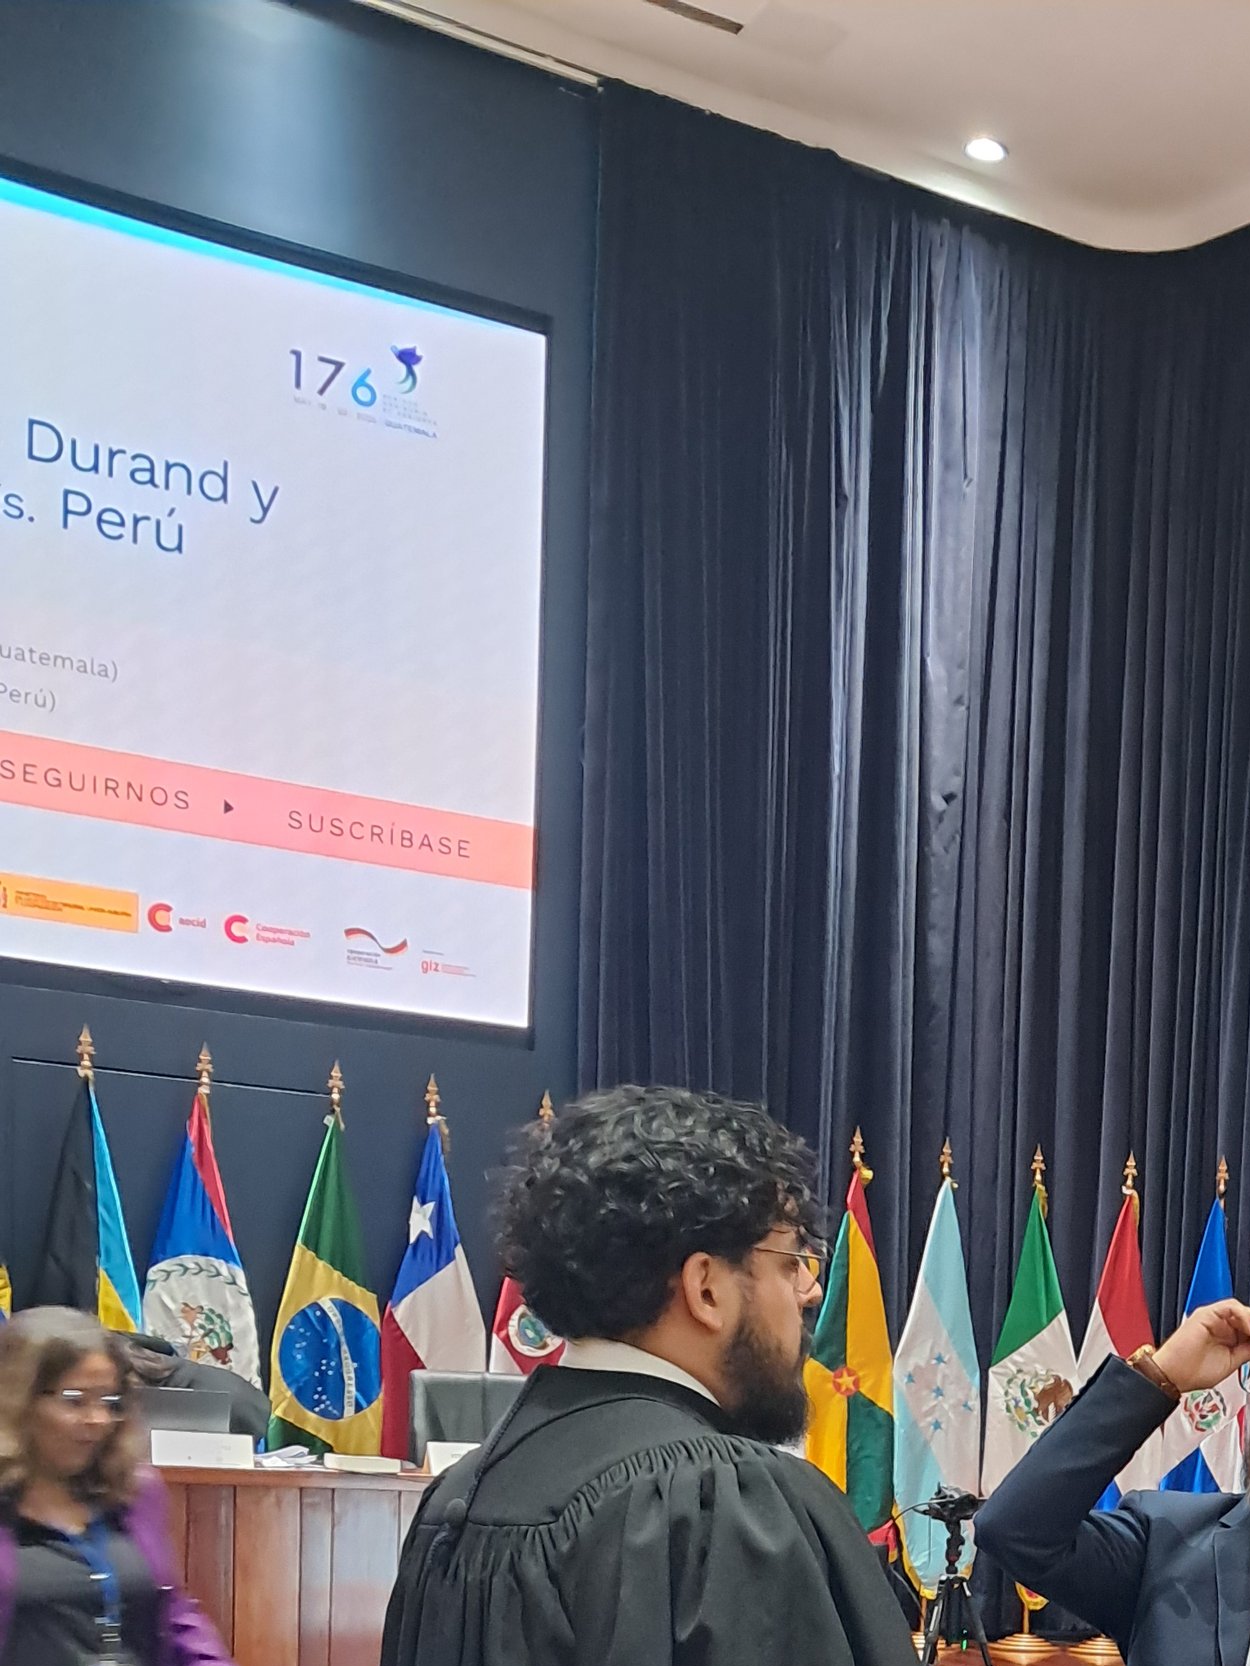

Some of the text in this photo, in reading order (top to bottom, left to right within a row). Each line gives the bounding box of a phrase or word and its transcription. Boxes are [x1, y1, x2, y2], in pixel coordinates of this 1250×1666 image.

[290, 349, 378, 408] 176
[26, 417, 281, 525] Durand y
[62, 487, 185, 555] Perú
[0, 759, 472, 859] SEGUIRNOS SUSCRÍBASE
